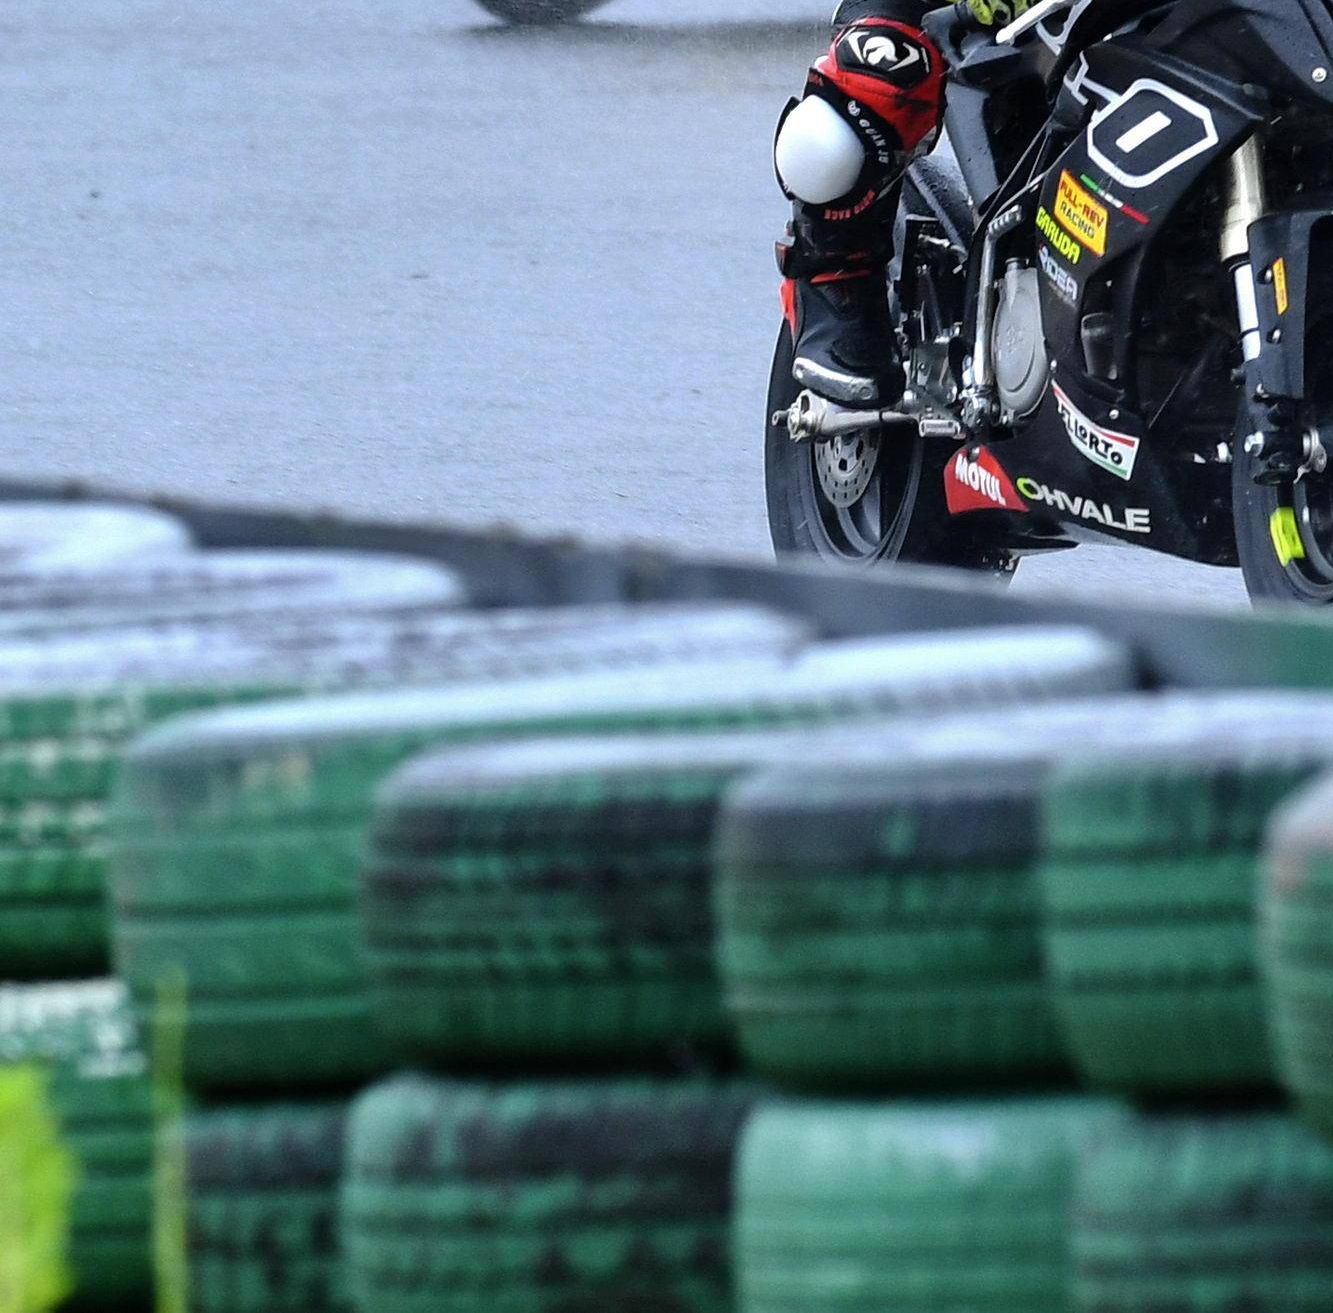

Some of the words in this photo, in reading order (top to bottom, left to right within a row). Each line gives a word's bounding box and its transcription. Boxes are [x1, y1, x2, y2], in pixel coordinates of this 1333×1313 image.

[1035, 206, 1081, 265] GARUDA
[1060, 200, 1096, 240] RACING
[955, 452, 1007, 507] MOTUL
[1016, 477, 1151, 533] OHVALE
